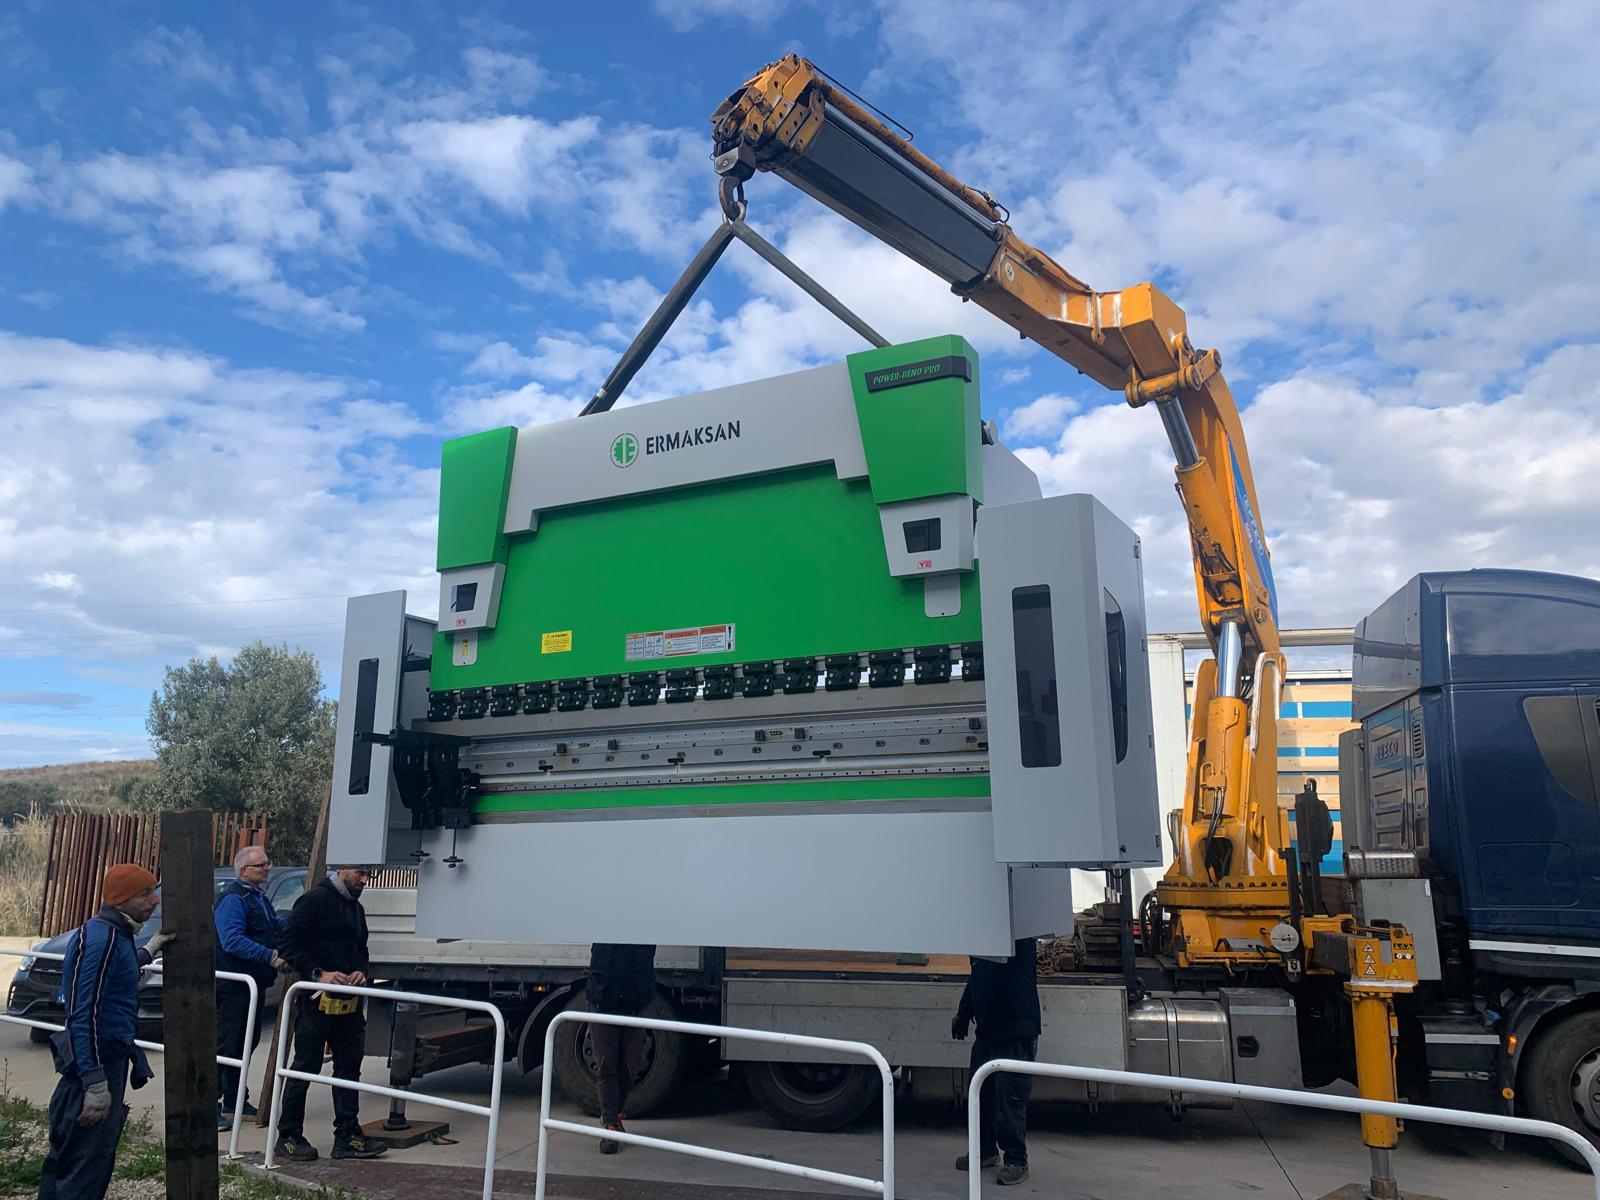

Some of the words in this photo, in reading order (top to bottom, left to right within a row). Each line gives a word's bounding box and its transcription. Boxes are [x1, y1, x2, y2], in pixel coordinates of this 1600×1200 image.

[873, 367, 922, 385] POWER-BEND
[924, 363, 941, 375] PRO
[646, 420, 741, 455] ERMAKSAN
[919, 560, 933, 569] Y2
[1376, 739, 1399, 761] IVECO
